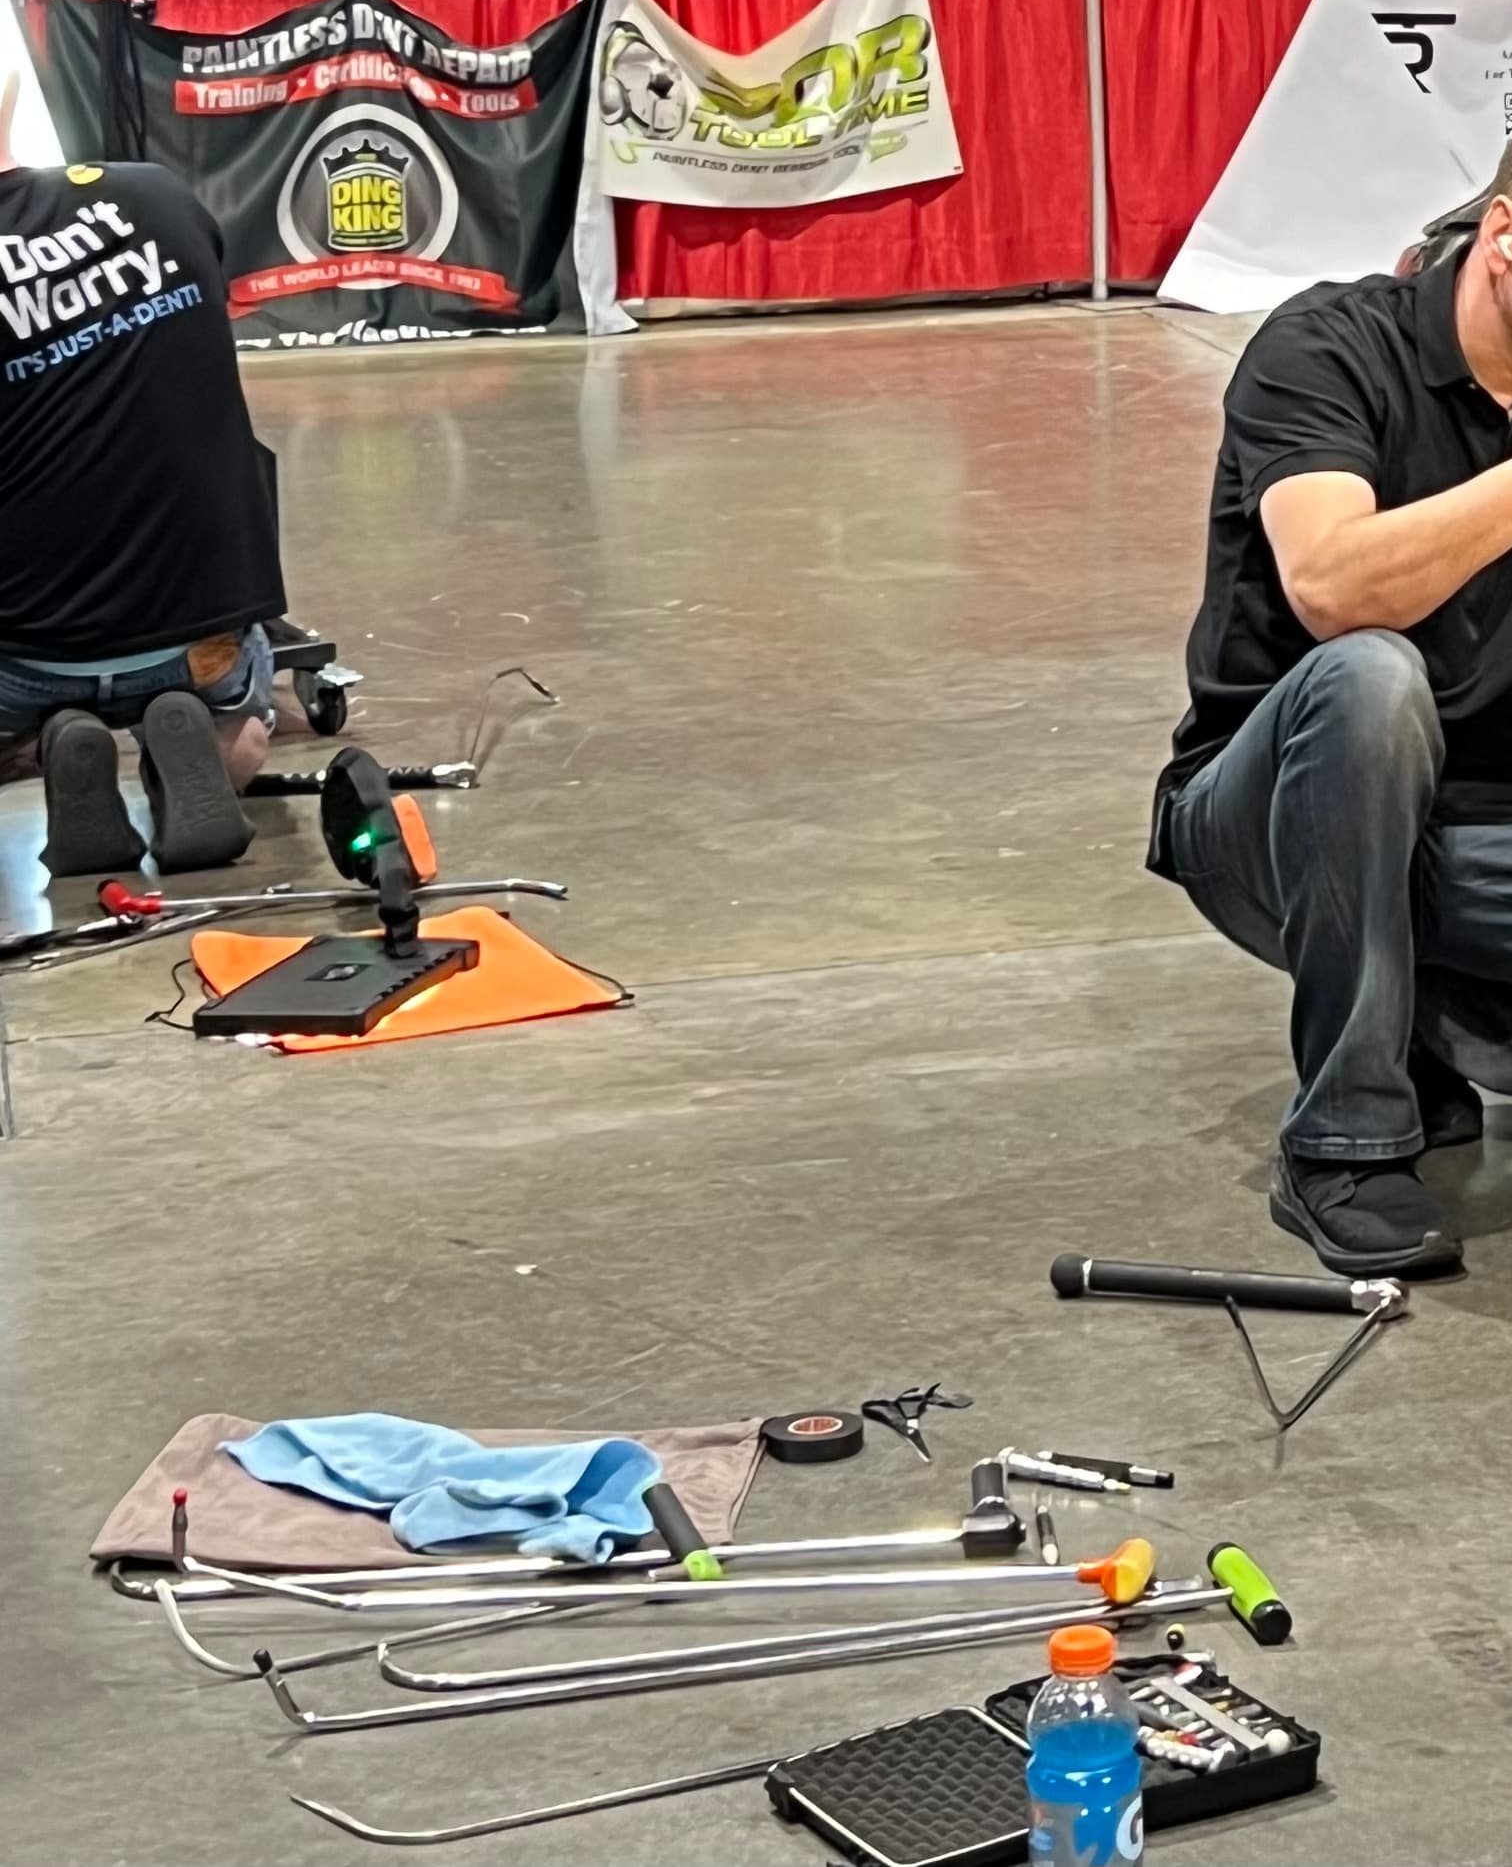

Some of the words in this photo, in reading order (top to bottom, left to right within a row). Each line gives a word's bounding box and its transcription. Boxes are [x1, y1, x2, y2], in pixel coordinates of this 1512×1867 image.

[182, 10, 348, 74] PAINTLESS
[194, 80, 288, 110] Training
[331, 176, 402, 207] DING
[332, 203, 402, 233] KING
[0, 201, 136, 284] Don't
[0, 239, 180, 340] Worry.
[247, 277, 279, 294] THE
[283, 265, 339, 286] WORLD
